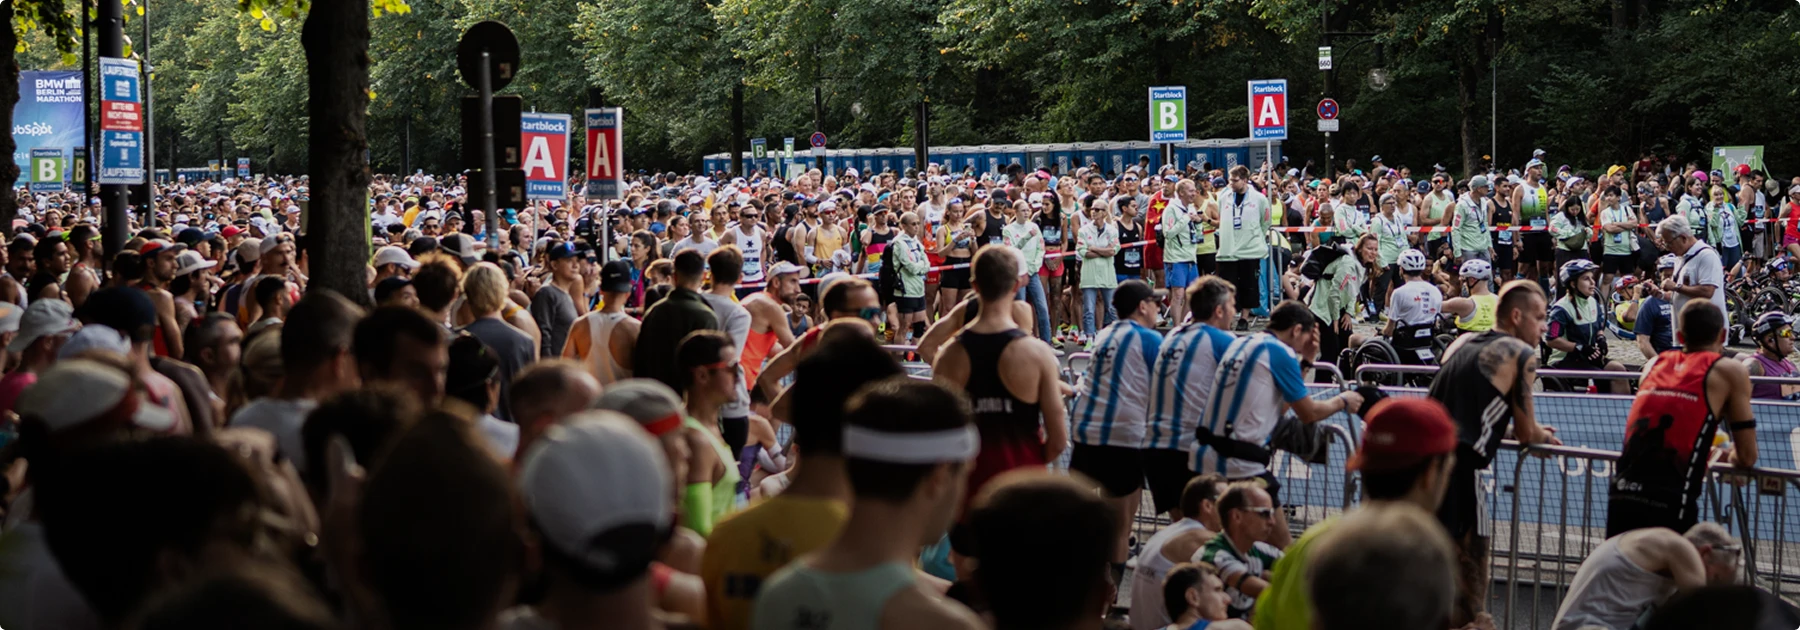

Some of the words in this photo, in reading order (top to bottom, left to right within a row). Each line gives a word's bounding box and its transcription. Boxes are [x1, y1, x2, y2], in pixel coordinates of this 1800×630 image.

[35, 79, 65, 89] BMW
[1153, 91, 1183, 99] Startblock
[1160, 101, 1178, 130] B
[1258, 96, 1280, 126] A
[12, 122, 53, 136] ubSpot
[522, 121, 565, 131] tartblock
[523, 136, 556, 178] A
[592, 132, 612, 177] A
[757, 145, 764, 158] B
[786, 145, 792, 158] B
[39, 159, 57, 182] B
[76, 159, 85, 182] B
[532, 183, 562, 192] EVENTS
